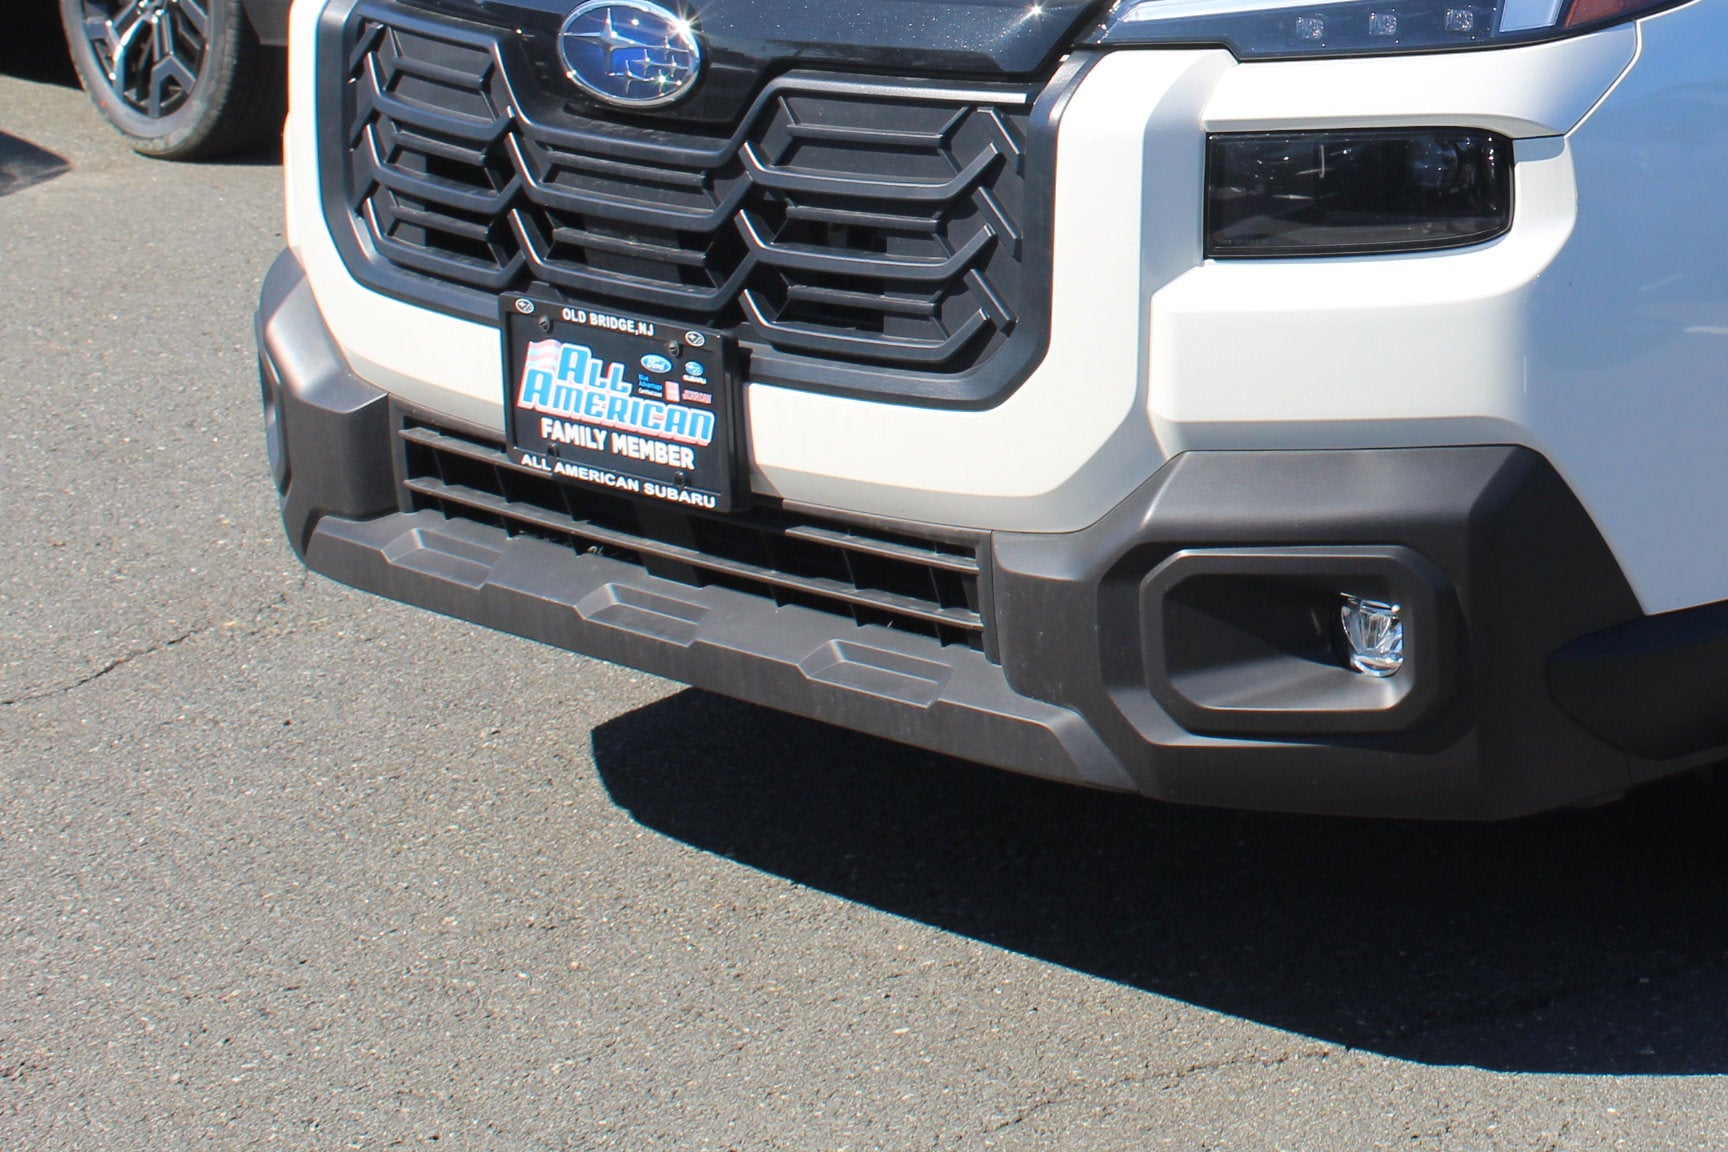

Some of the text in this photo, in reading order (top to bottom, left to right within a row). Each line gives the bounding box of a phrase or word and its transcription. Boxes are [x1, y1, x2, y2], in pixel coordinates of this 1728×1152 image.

[562, 307, 587, 323] OLD
[556, 342, 633, 396] ALL
[517, 367, 715, 447] AMERICAN
[540, 417, 695, 470] FAMILY MEMBER
[521, 453, 716, 508] ALL AMERICAN SUBARU
